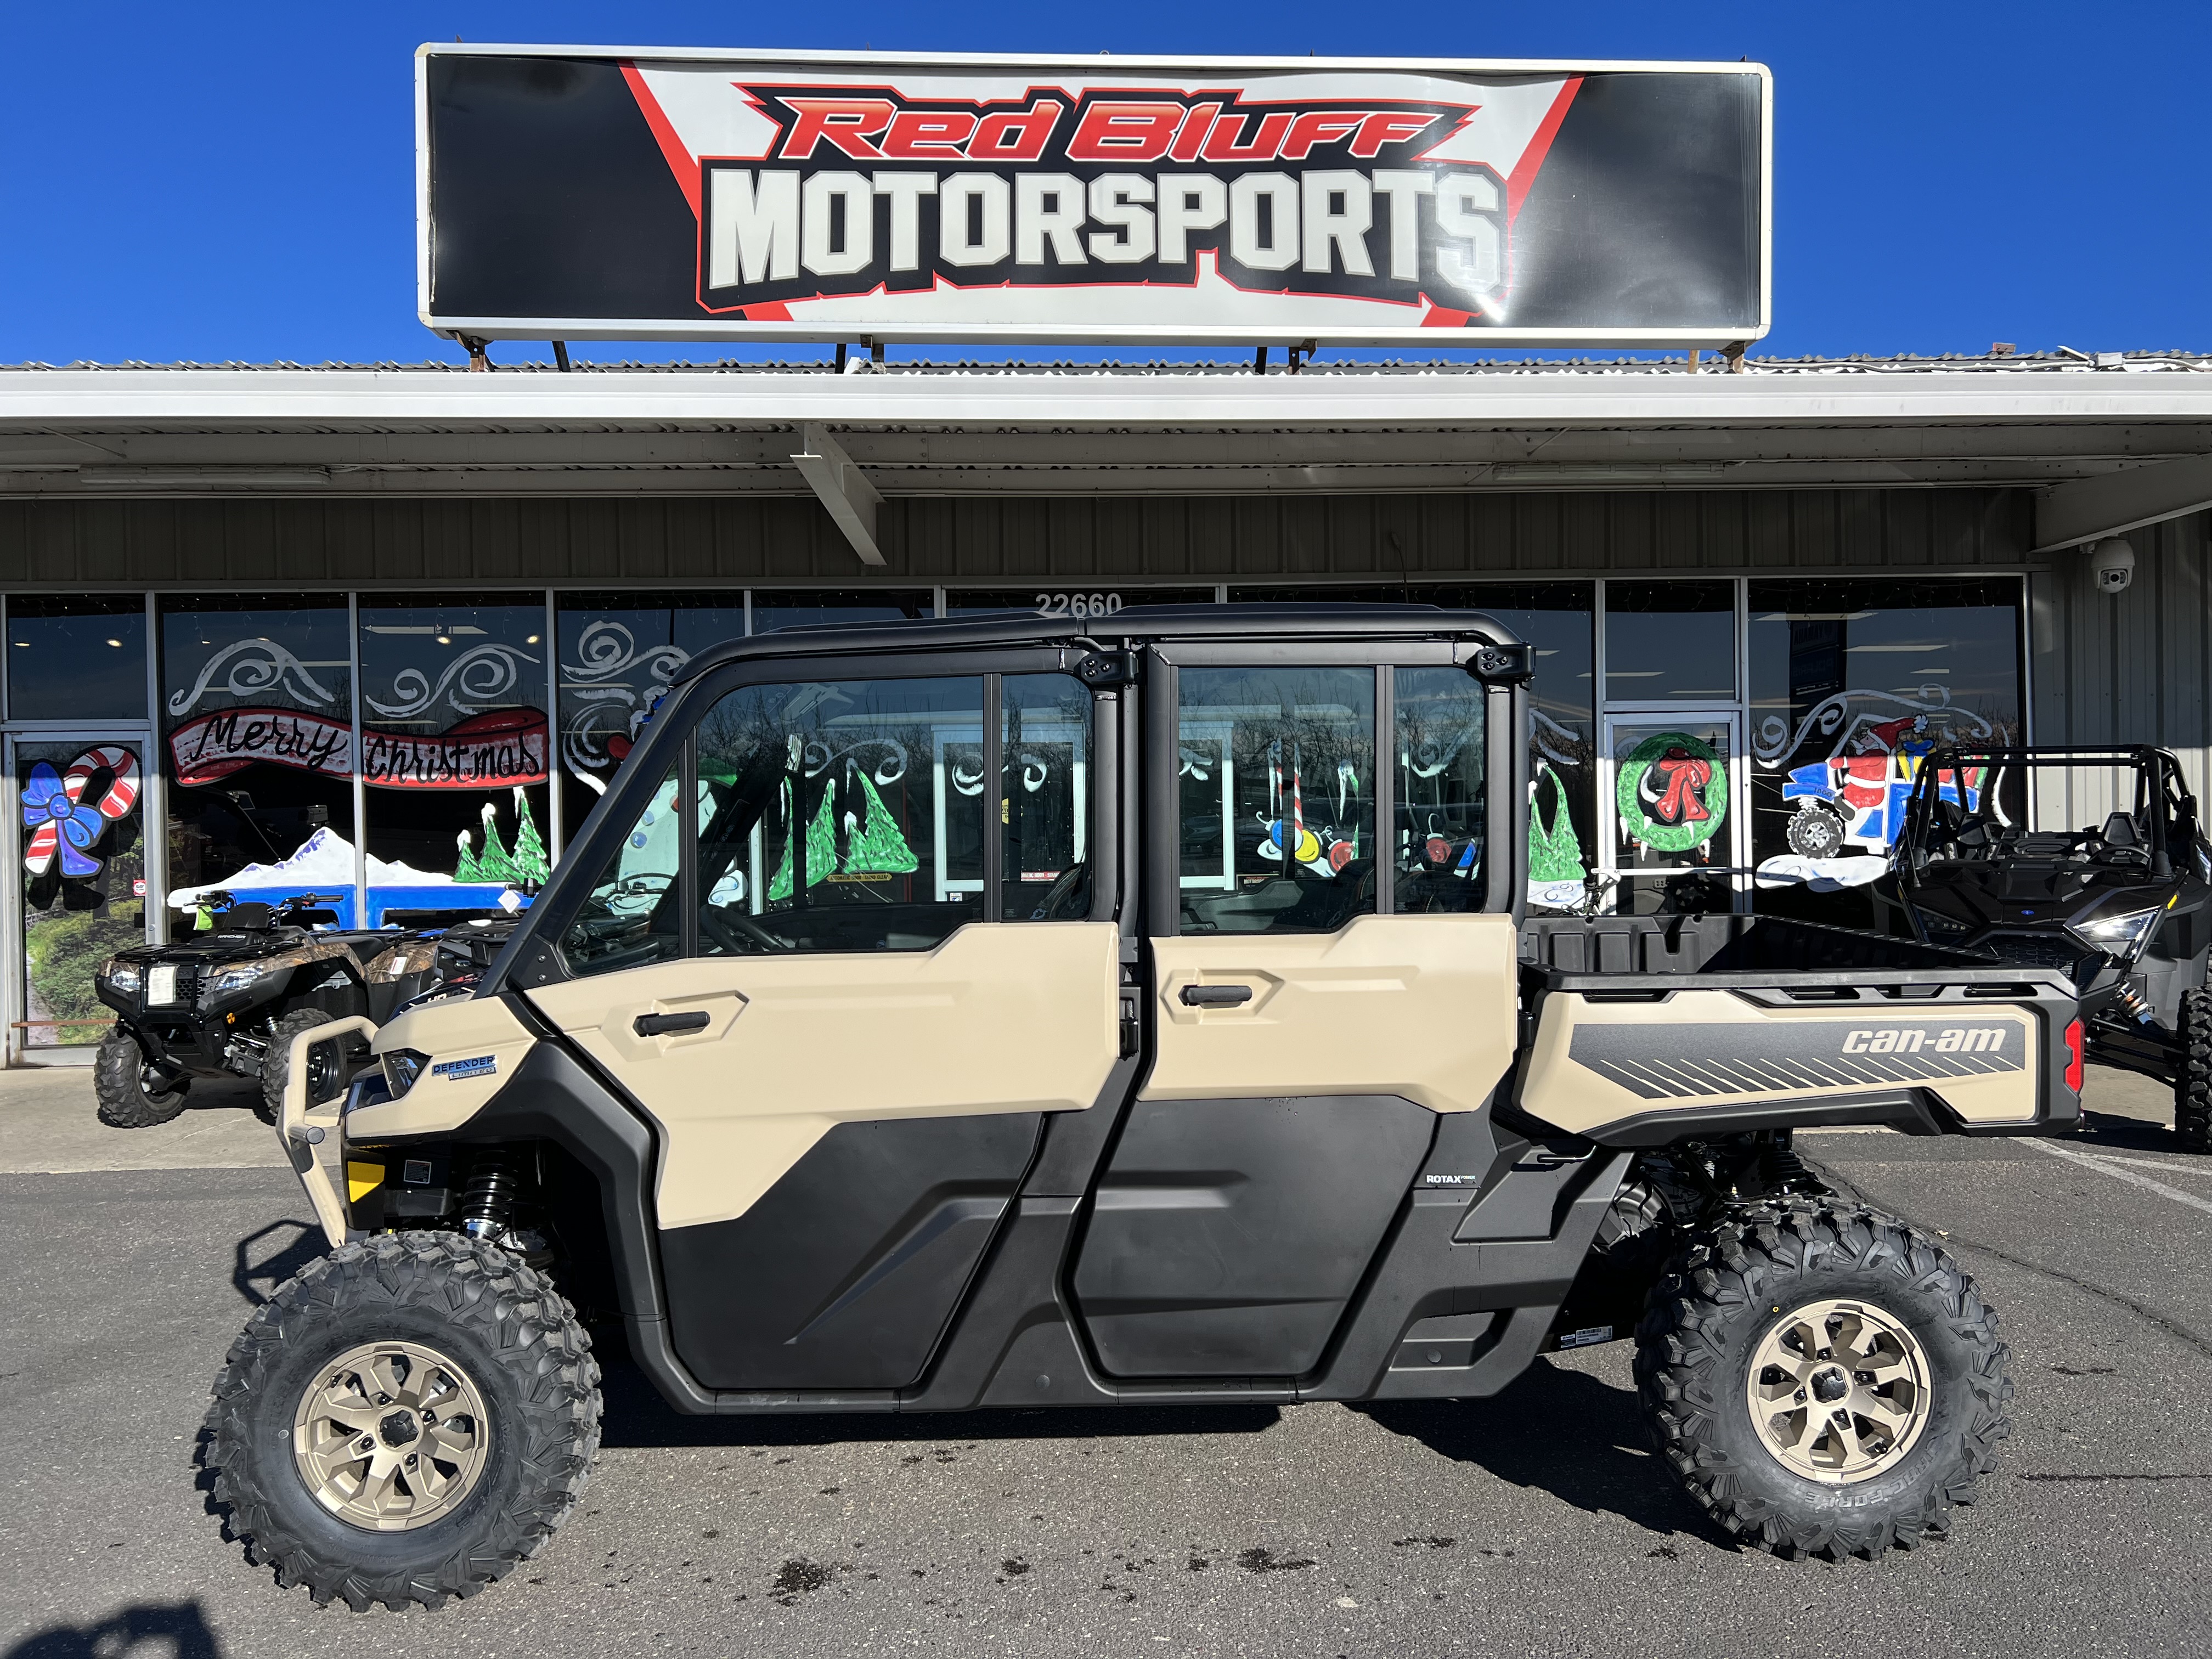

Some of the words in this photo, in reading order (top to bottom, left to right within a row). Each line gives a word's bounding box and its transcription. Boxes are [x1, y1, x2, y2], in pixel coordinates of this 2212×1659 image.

[774, 99, 1065, 160] Red
[709, 168, 1501, 294] MOTORSPORTS
[1036, 593, 1122, 618] 22660
[190, 712, 348, 770] Merry
[367, 732, 539, 783] Christmas
[1842, 1029, 2006, 1053] can-am
[433, 1056, 495, 1073] DEFENDER
[452, 1068, 492, 1078] LIMITED
[1426, 1175, 1461, 1183] ROTAX
